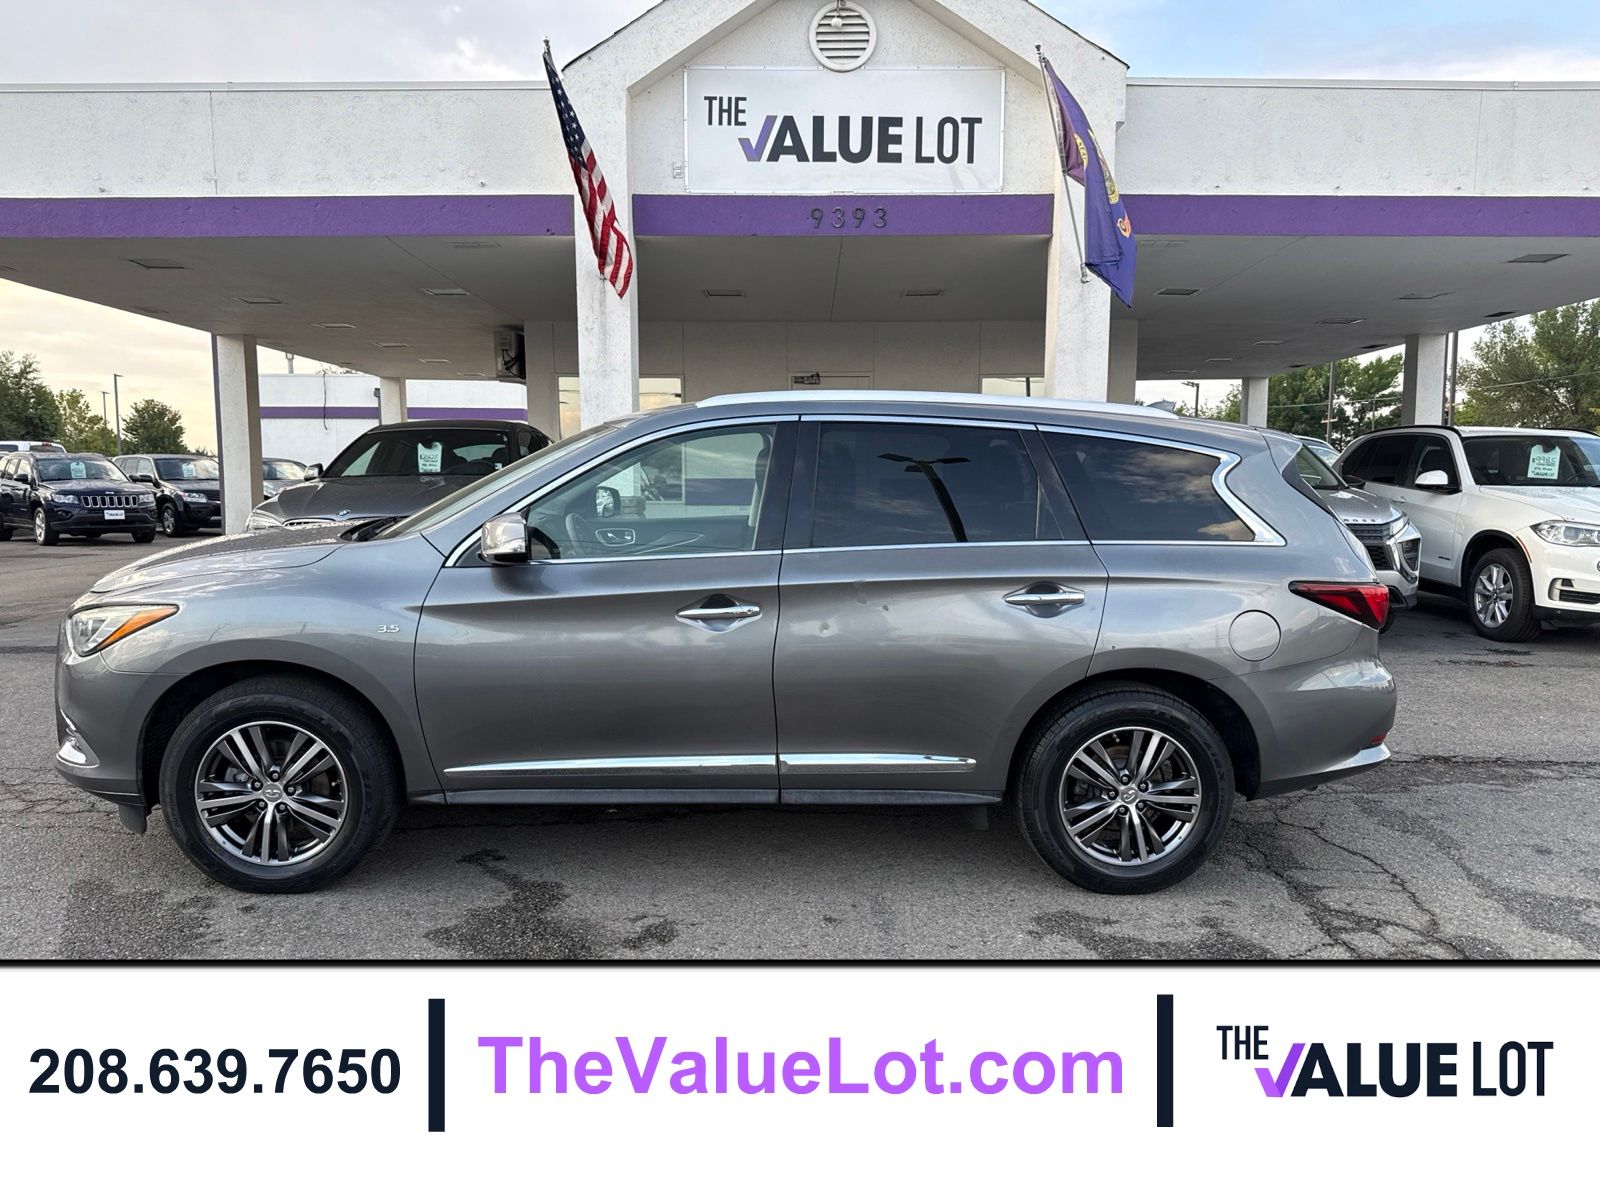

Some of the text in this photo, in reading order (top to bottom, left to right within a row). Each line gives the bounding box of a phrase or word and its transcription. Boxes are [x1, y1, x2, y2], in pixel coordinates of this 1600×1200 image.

[704, 96, 983, 164] THE VALUE LOT
[810, 206, 888, 229] 9393
[377, 624, 400, 633] 3.5
